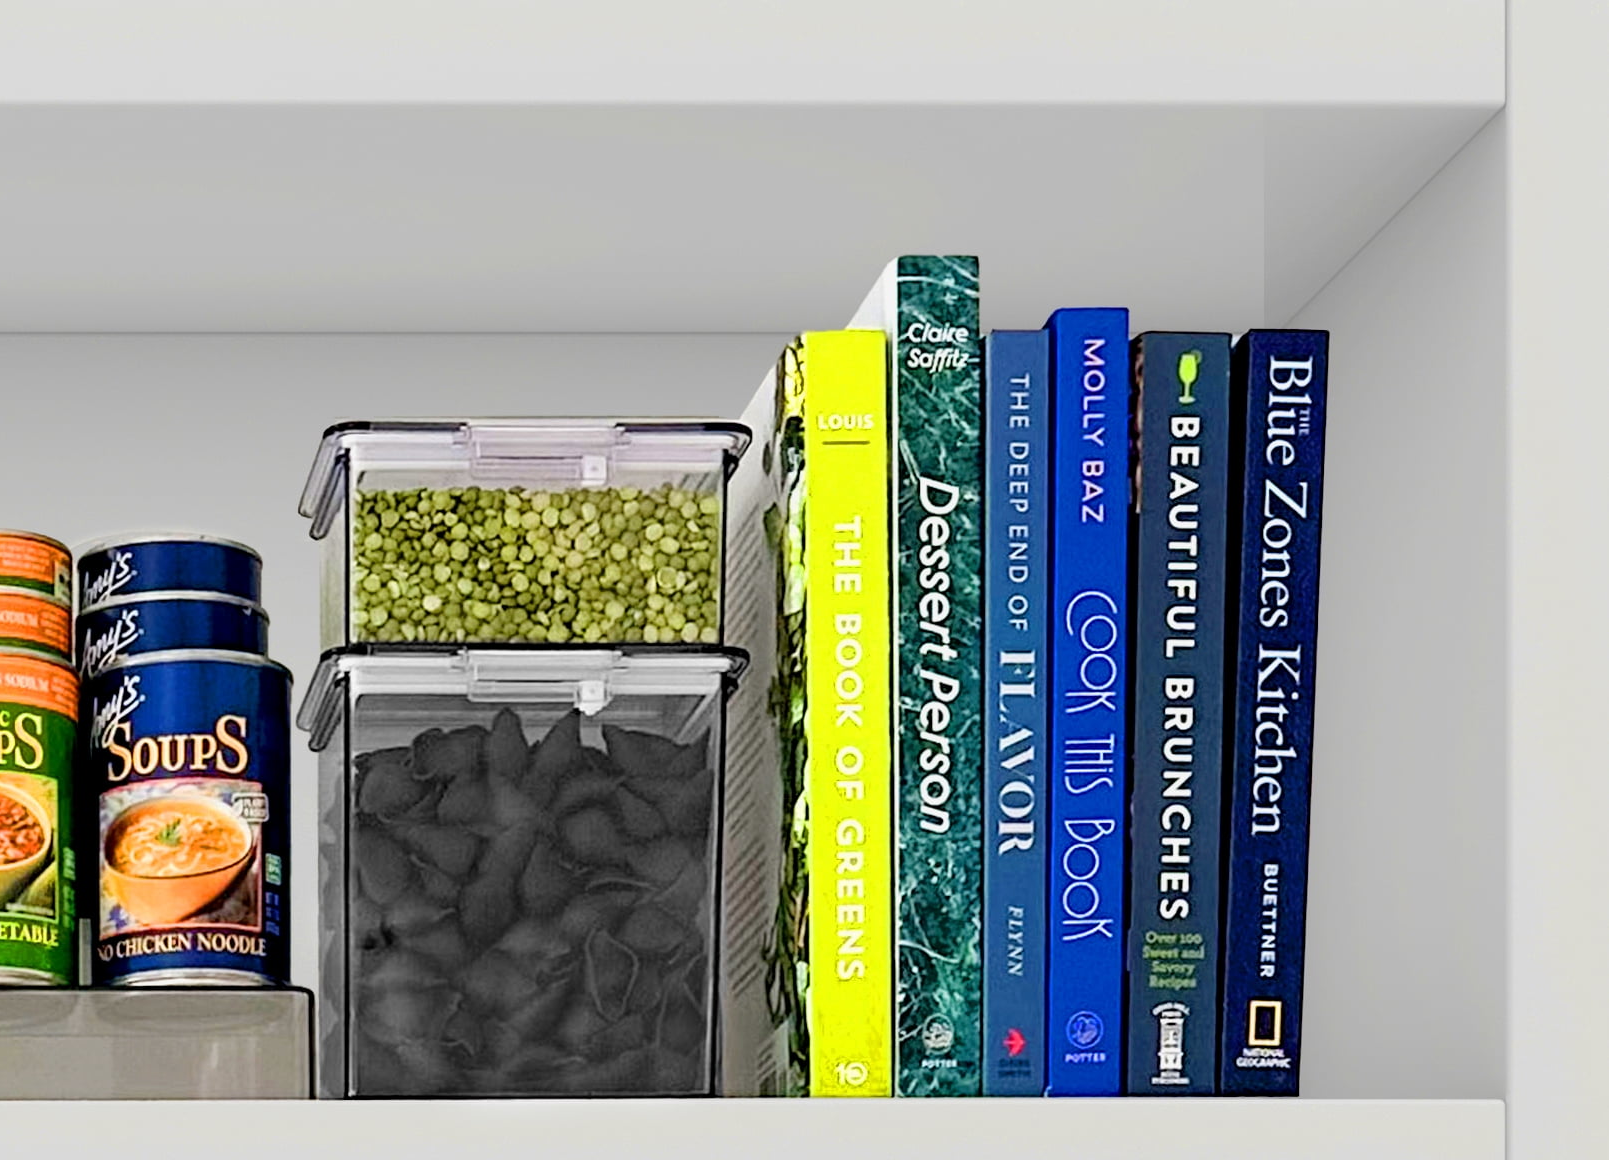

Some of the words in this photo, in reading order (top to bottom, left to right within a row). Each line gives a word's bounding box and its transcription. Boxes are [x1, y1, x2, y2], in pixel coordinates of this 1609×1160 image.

[907, 322, 969, 343] Claire
[907, 348, 968, 373] Saffitz
[817, 414, 875, 431] LOUIS
[1009, 373, 1030, 429] THE
[1082, 339, 1106, 447] MOLLY
[1266, 355, 1313, 466] Blue
[1299, 408, 1311, 436] THE
[1009, 442, 1029, 513] DEEP
[1082, 460, 1104, 523] BAZ
[834, 515, 862, 594] THE
[919, 476, 960, 661] Dessert
[1008, 525, 1029, 583] END
[1165, 416, 1201, 658] BEAUTIFUL
[1259, 479, 1308, 628] Zones
[1007, 595, 1028, 632] OF
[5, 673, 50, 693] SODIUM
[834, 613, 864, 728] BOOK
[1064, 590, 1119, 713] COOK
[108, 714, 249, 782] SOUPS
[835, 746, 865, 802] OF
[919, 669, 960, 834] Person
[998, 650, 1036, 855] FLAVOR
[1251, 643, 1302, 837] Kitchen
[1159, 677, 1195, 920] BRUNCHES
[836, 818, 866, 982] GREENS
[1062, 819, 1116, 941] BOOK
[116, 932, 191, 959] CHICKEN
[197, 932, 267, 957] NOODLE
[1007, 905, 1025, 977] FLYNN
[1145, 931, 1178, 944] Over
[1180, 932, 1202, 945] 100
[1181, 945, 1205, 959] and
[1259, 863, 1279, 978] BUETTNER
[1149, 976, 1197, 990] Recipes
[1151, 960, 1195, 975] Savory
[922, 1059, 958, 1068] POTTER
[1064, 1052, 1106, 1063] POTTER
